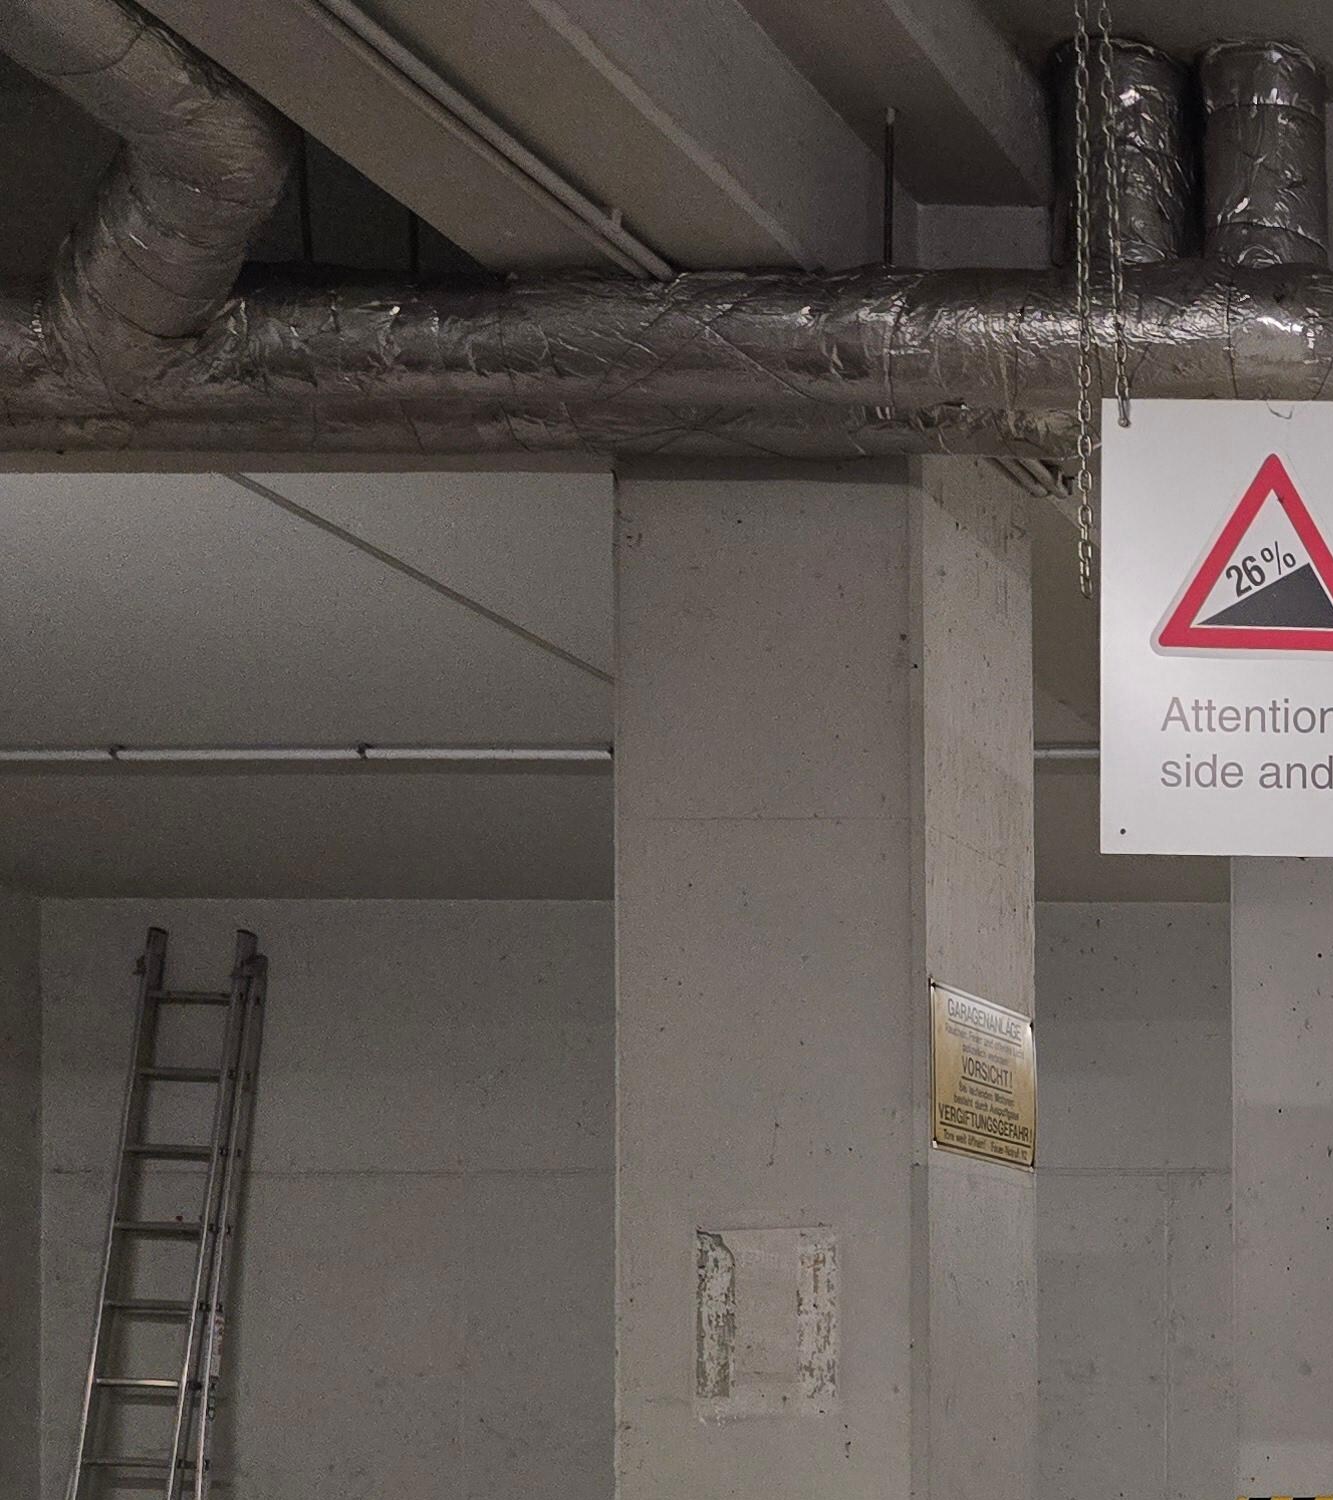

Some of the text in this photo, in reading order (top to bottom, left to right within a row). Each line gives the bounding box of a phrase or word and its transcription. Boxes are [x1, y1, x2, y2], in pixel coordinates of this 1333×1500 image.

[1225, 540, 1297, 598] 26%
[1160, 753, 1244, 789] side
[1259, 754, 1333, 790] and
[947, 998, 1022, 1041] GARAGENANLAGE
[961, 1055, 1013, 1088] VORSICHT!
[938, 1102, 1032, 1143] VERGIFTUNGSGEFAHR!
